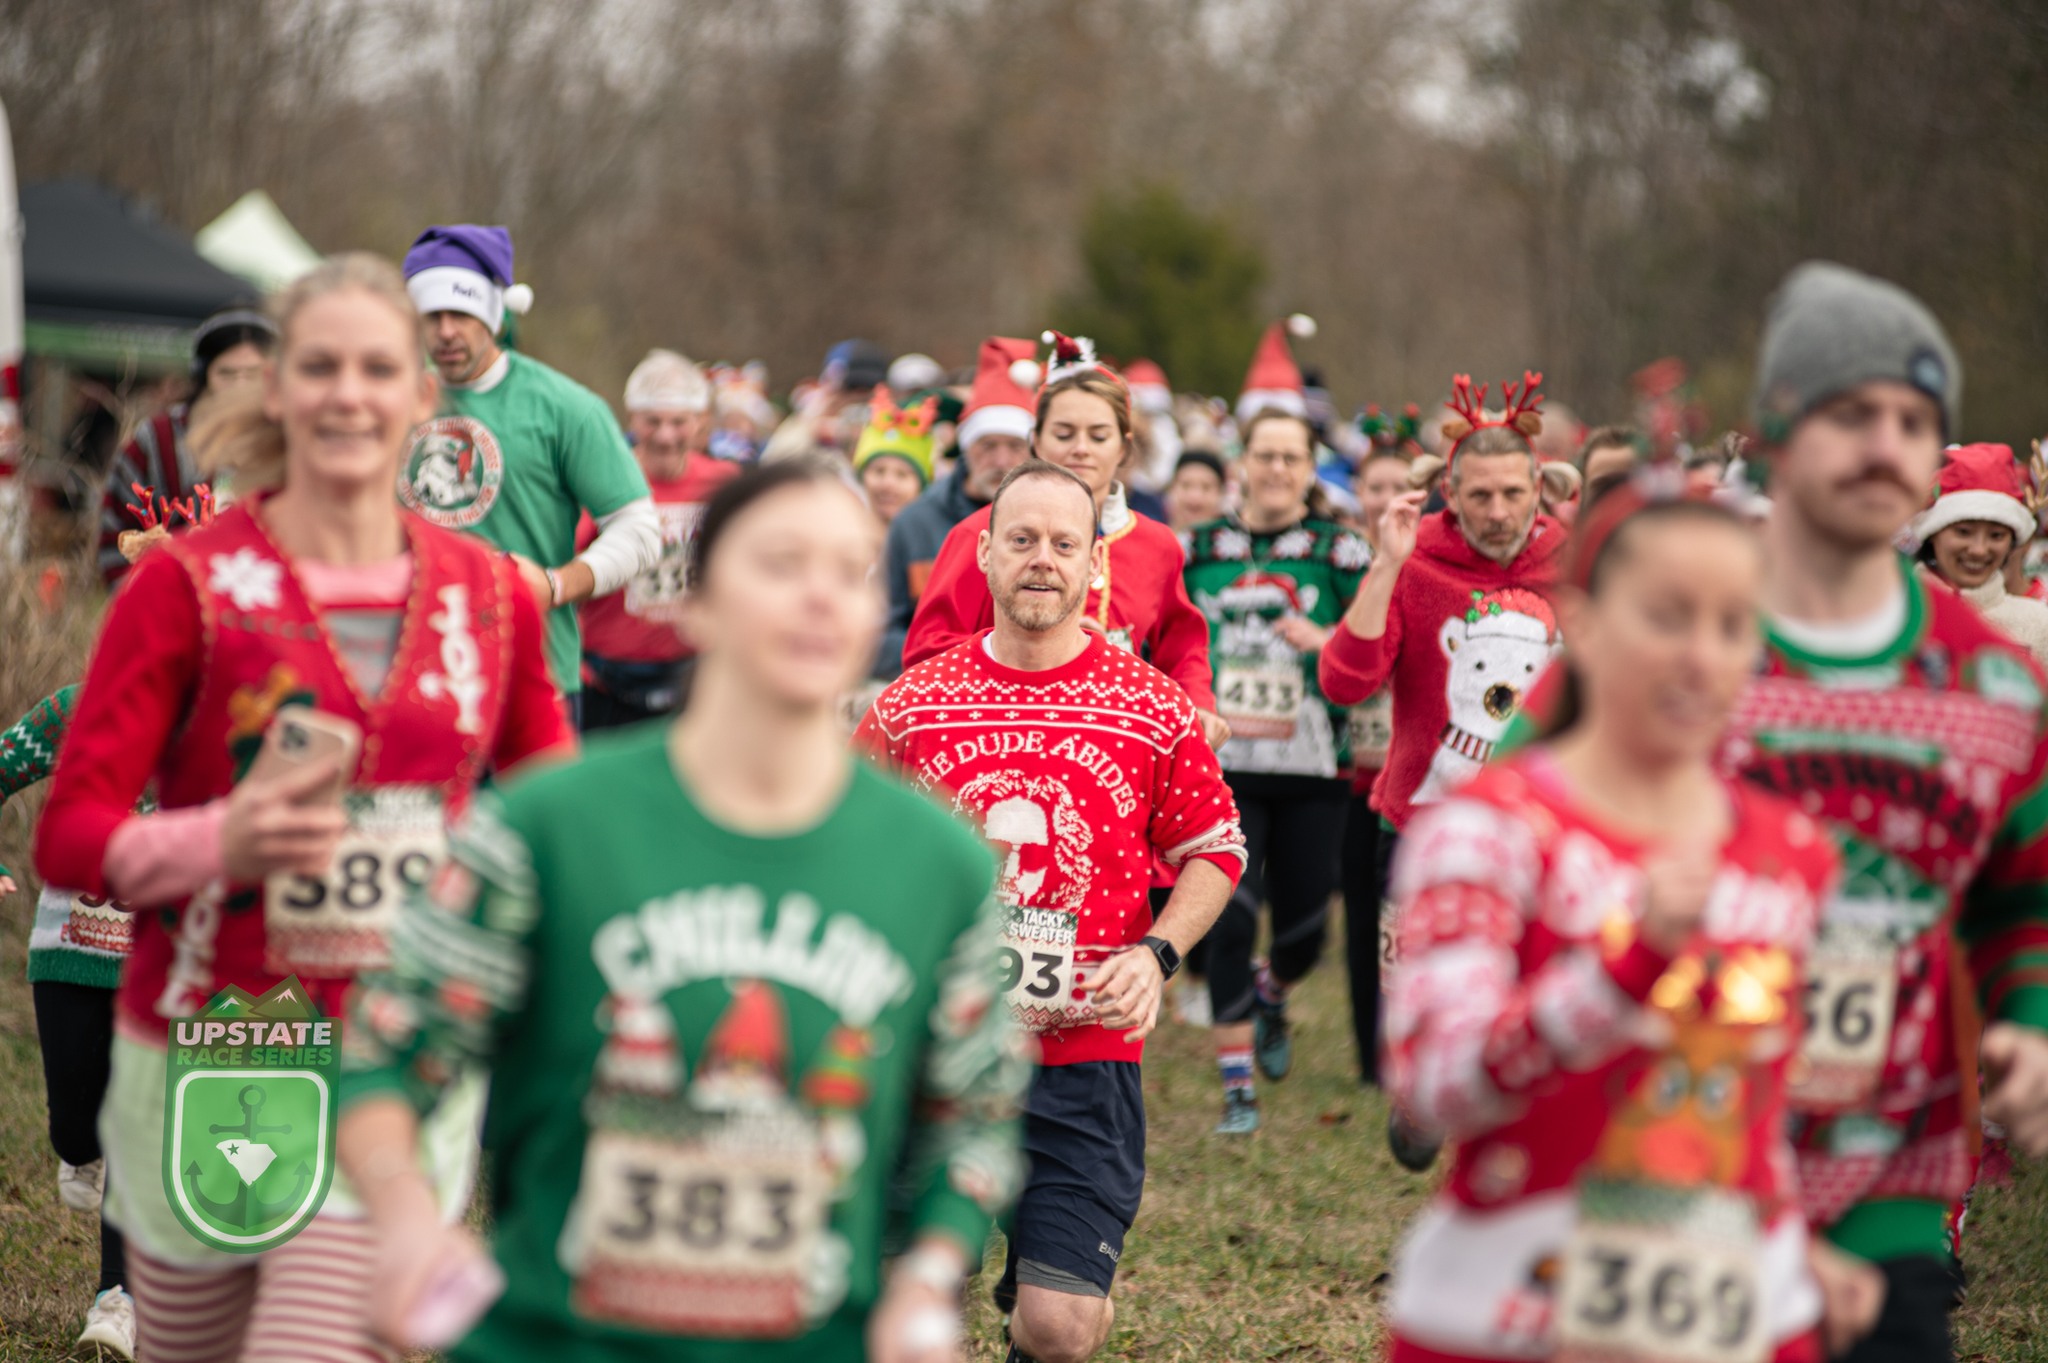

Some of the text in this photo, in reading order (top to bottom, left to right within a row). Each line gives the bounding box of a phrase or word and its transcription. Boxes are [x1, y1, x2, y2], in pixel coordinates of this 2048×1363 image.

[954, 731, 1046, 764] DUDE
[1049, 736, 1138, 819] ABIDES
[1008, 922, 1073, 944] SWEATER
[1022, 909, 1066, 926] TACKY
[608, 1166, 797, 1252] 383
[1578, 1248, 1752, 1348] 369
